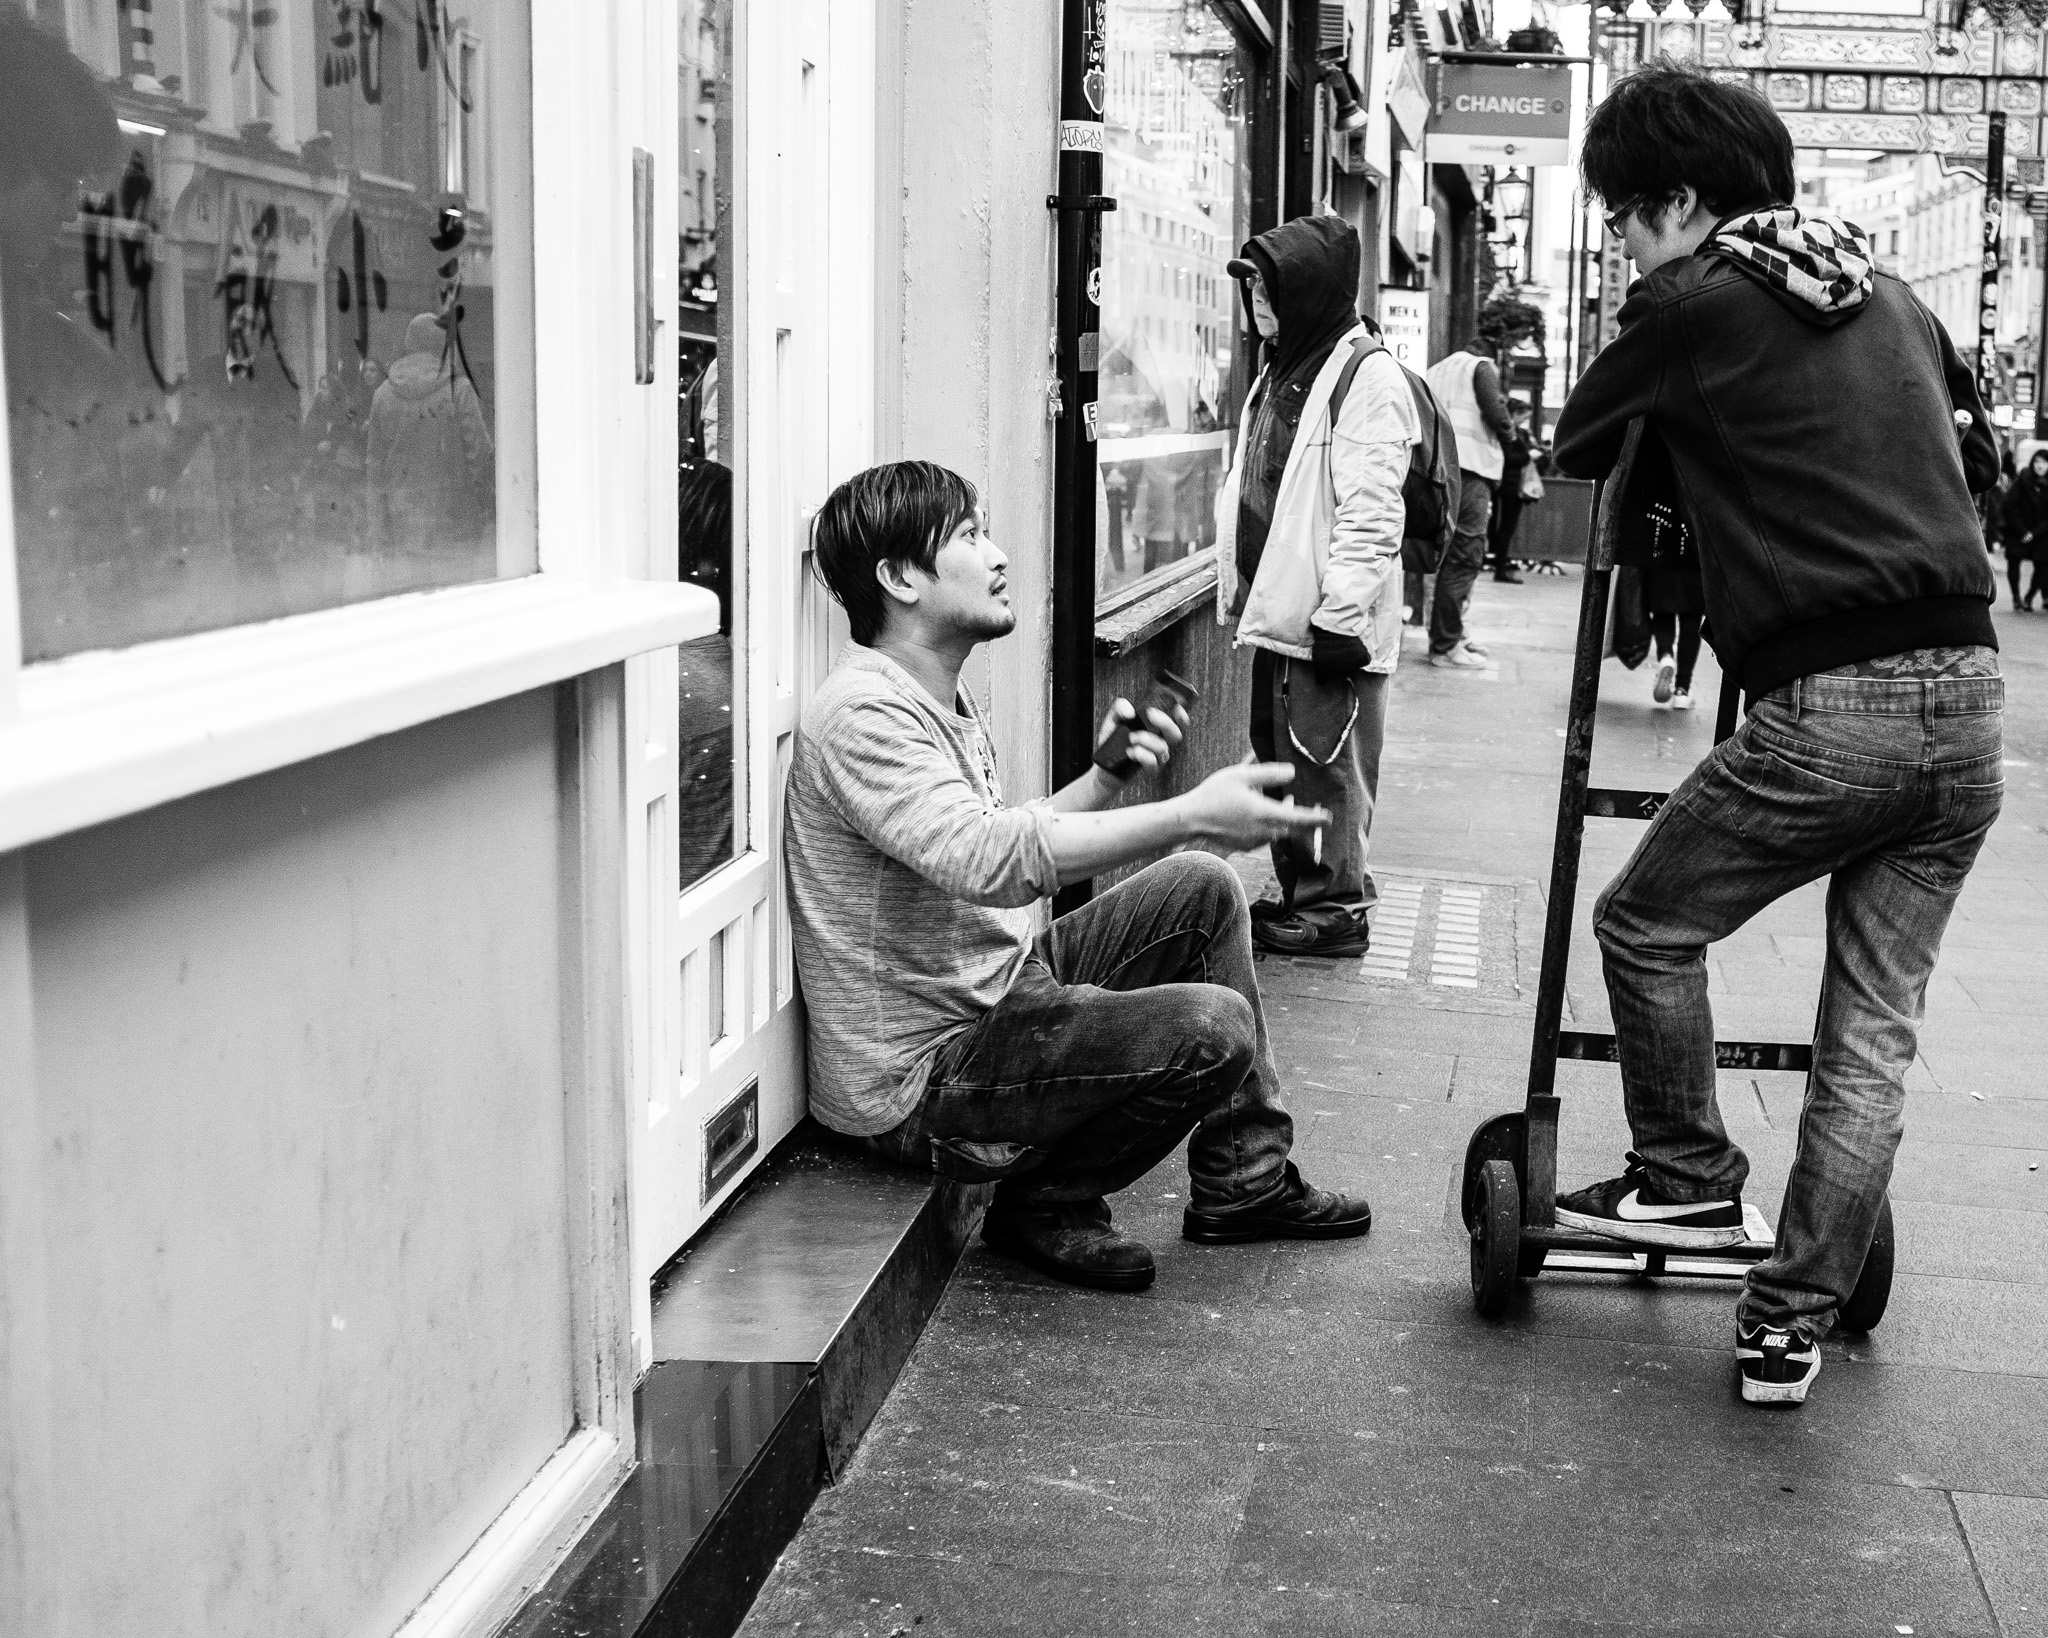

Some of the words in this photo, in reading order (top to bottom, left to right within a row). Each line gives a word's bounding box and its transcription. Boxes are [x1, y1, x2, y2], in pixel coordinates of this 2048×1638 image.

[1455, 94, 1546, 115] CHANGE
[1389, 305, 1409, 318] MEN
[1384, 324, 1422, 337] WOMEN
[1761, 1334, 1791, 1348] NIKE
